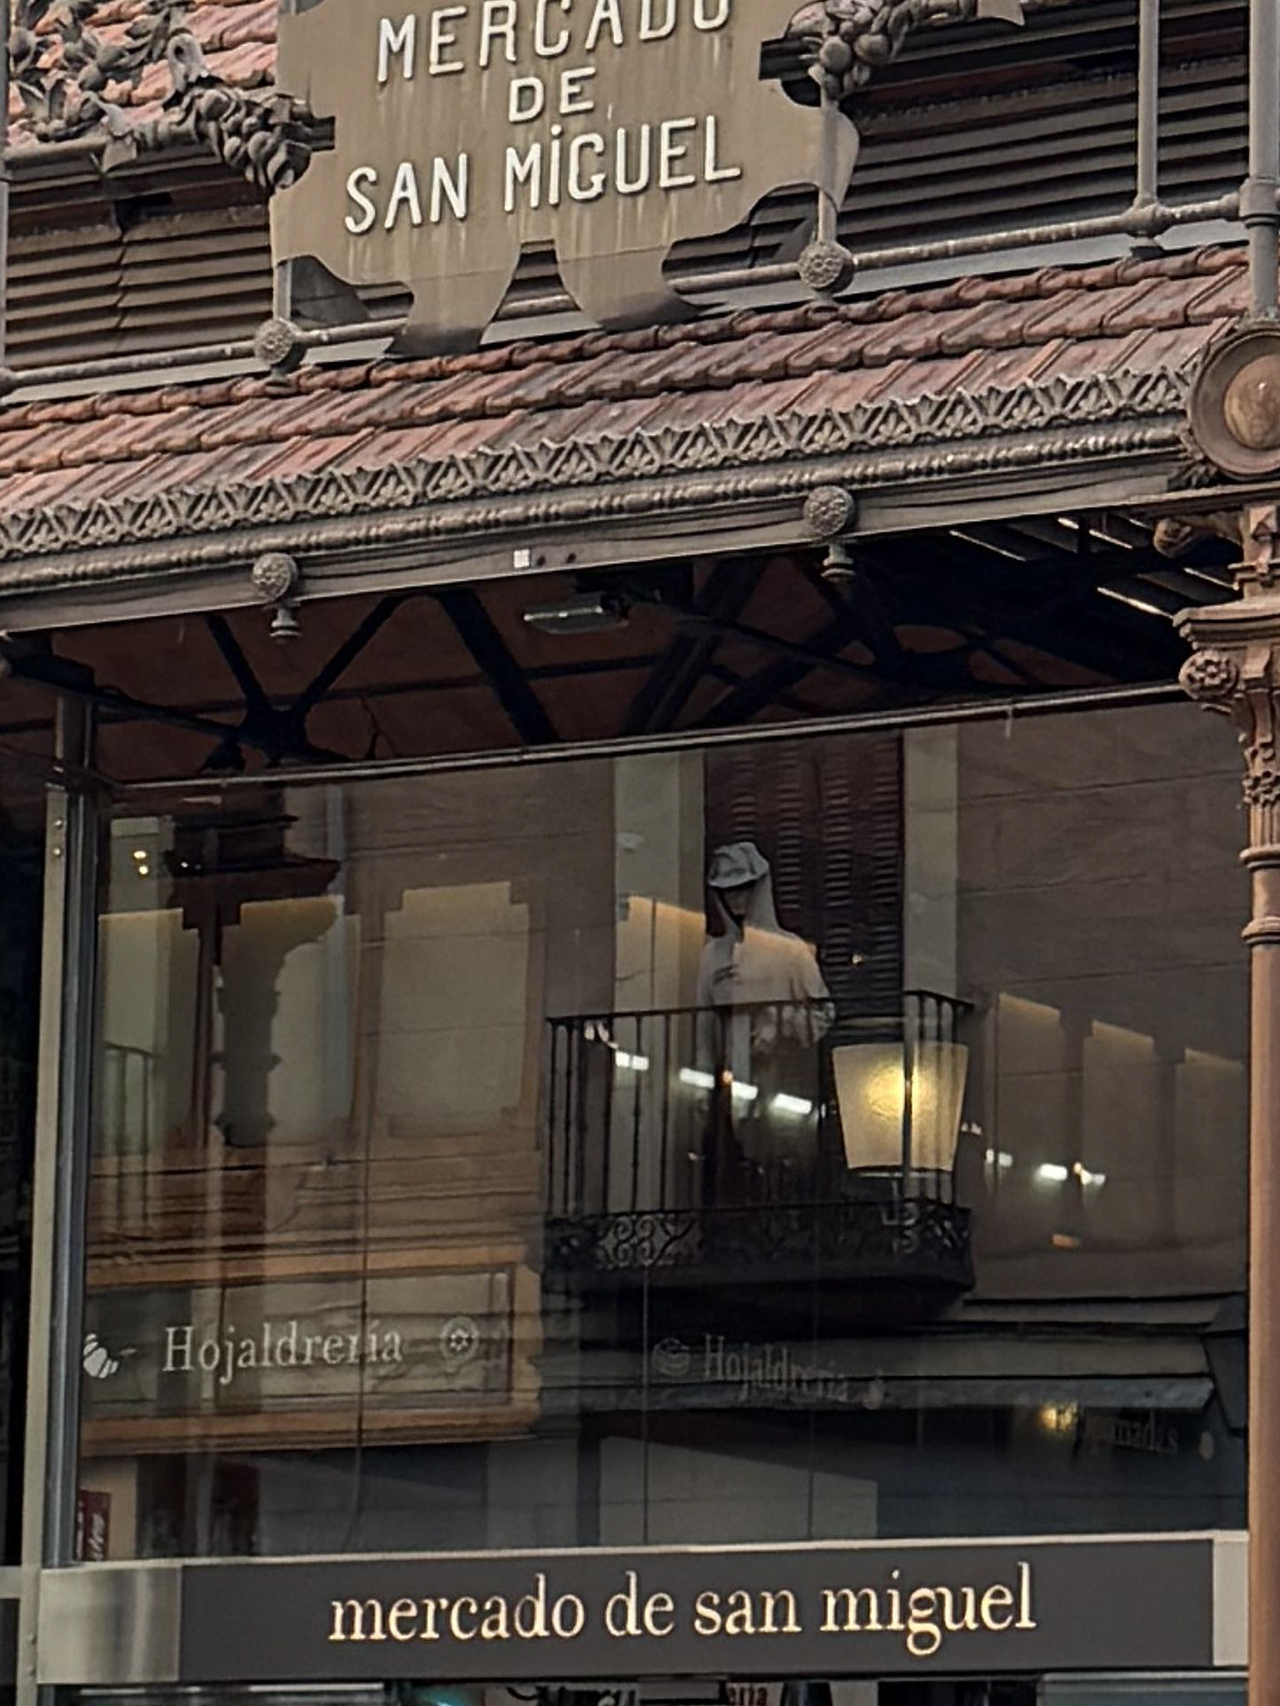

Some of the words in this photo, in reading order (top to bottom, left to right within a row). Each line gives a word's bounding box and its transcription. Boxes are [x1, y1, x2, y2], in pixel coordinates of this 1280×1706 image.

[507, 65, 597, 124] DE
[343, 149, 471, 236] SAN
[162, 1319, 404, 1385] Hojaldrería
[328, 1573, 586, 1641] mercado
[604, 1569, 675, 1638] de
[693, 1586, 802, 1637] san
[819, 1561, 1038, 1658] miguel
